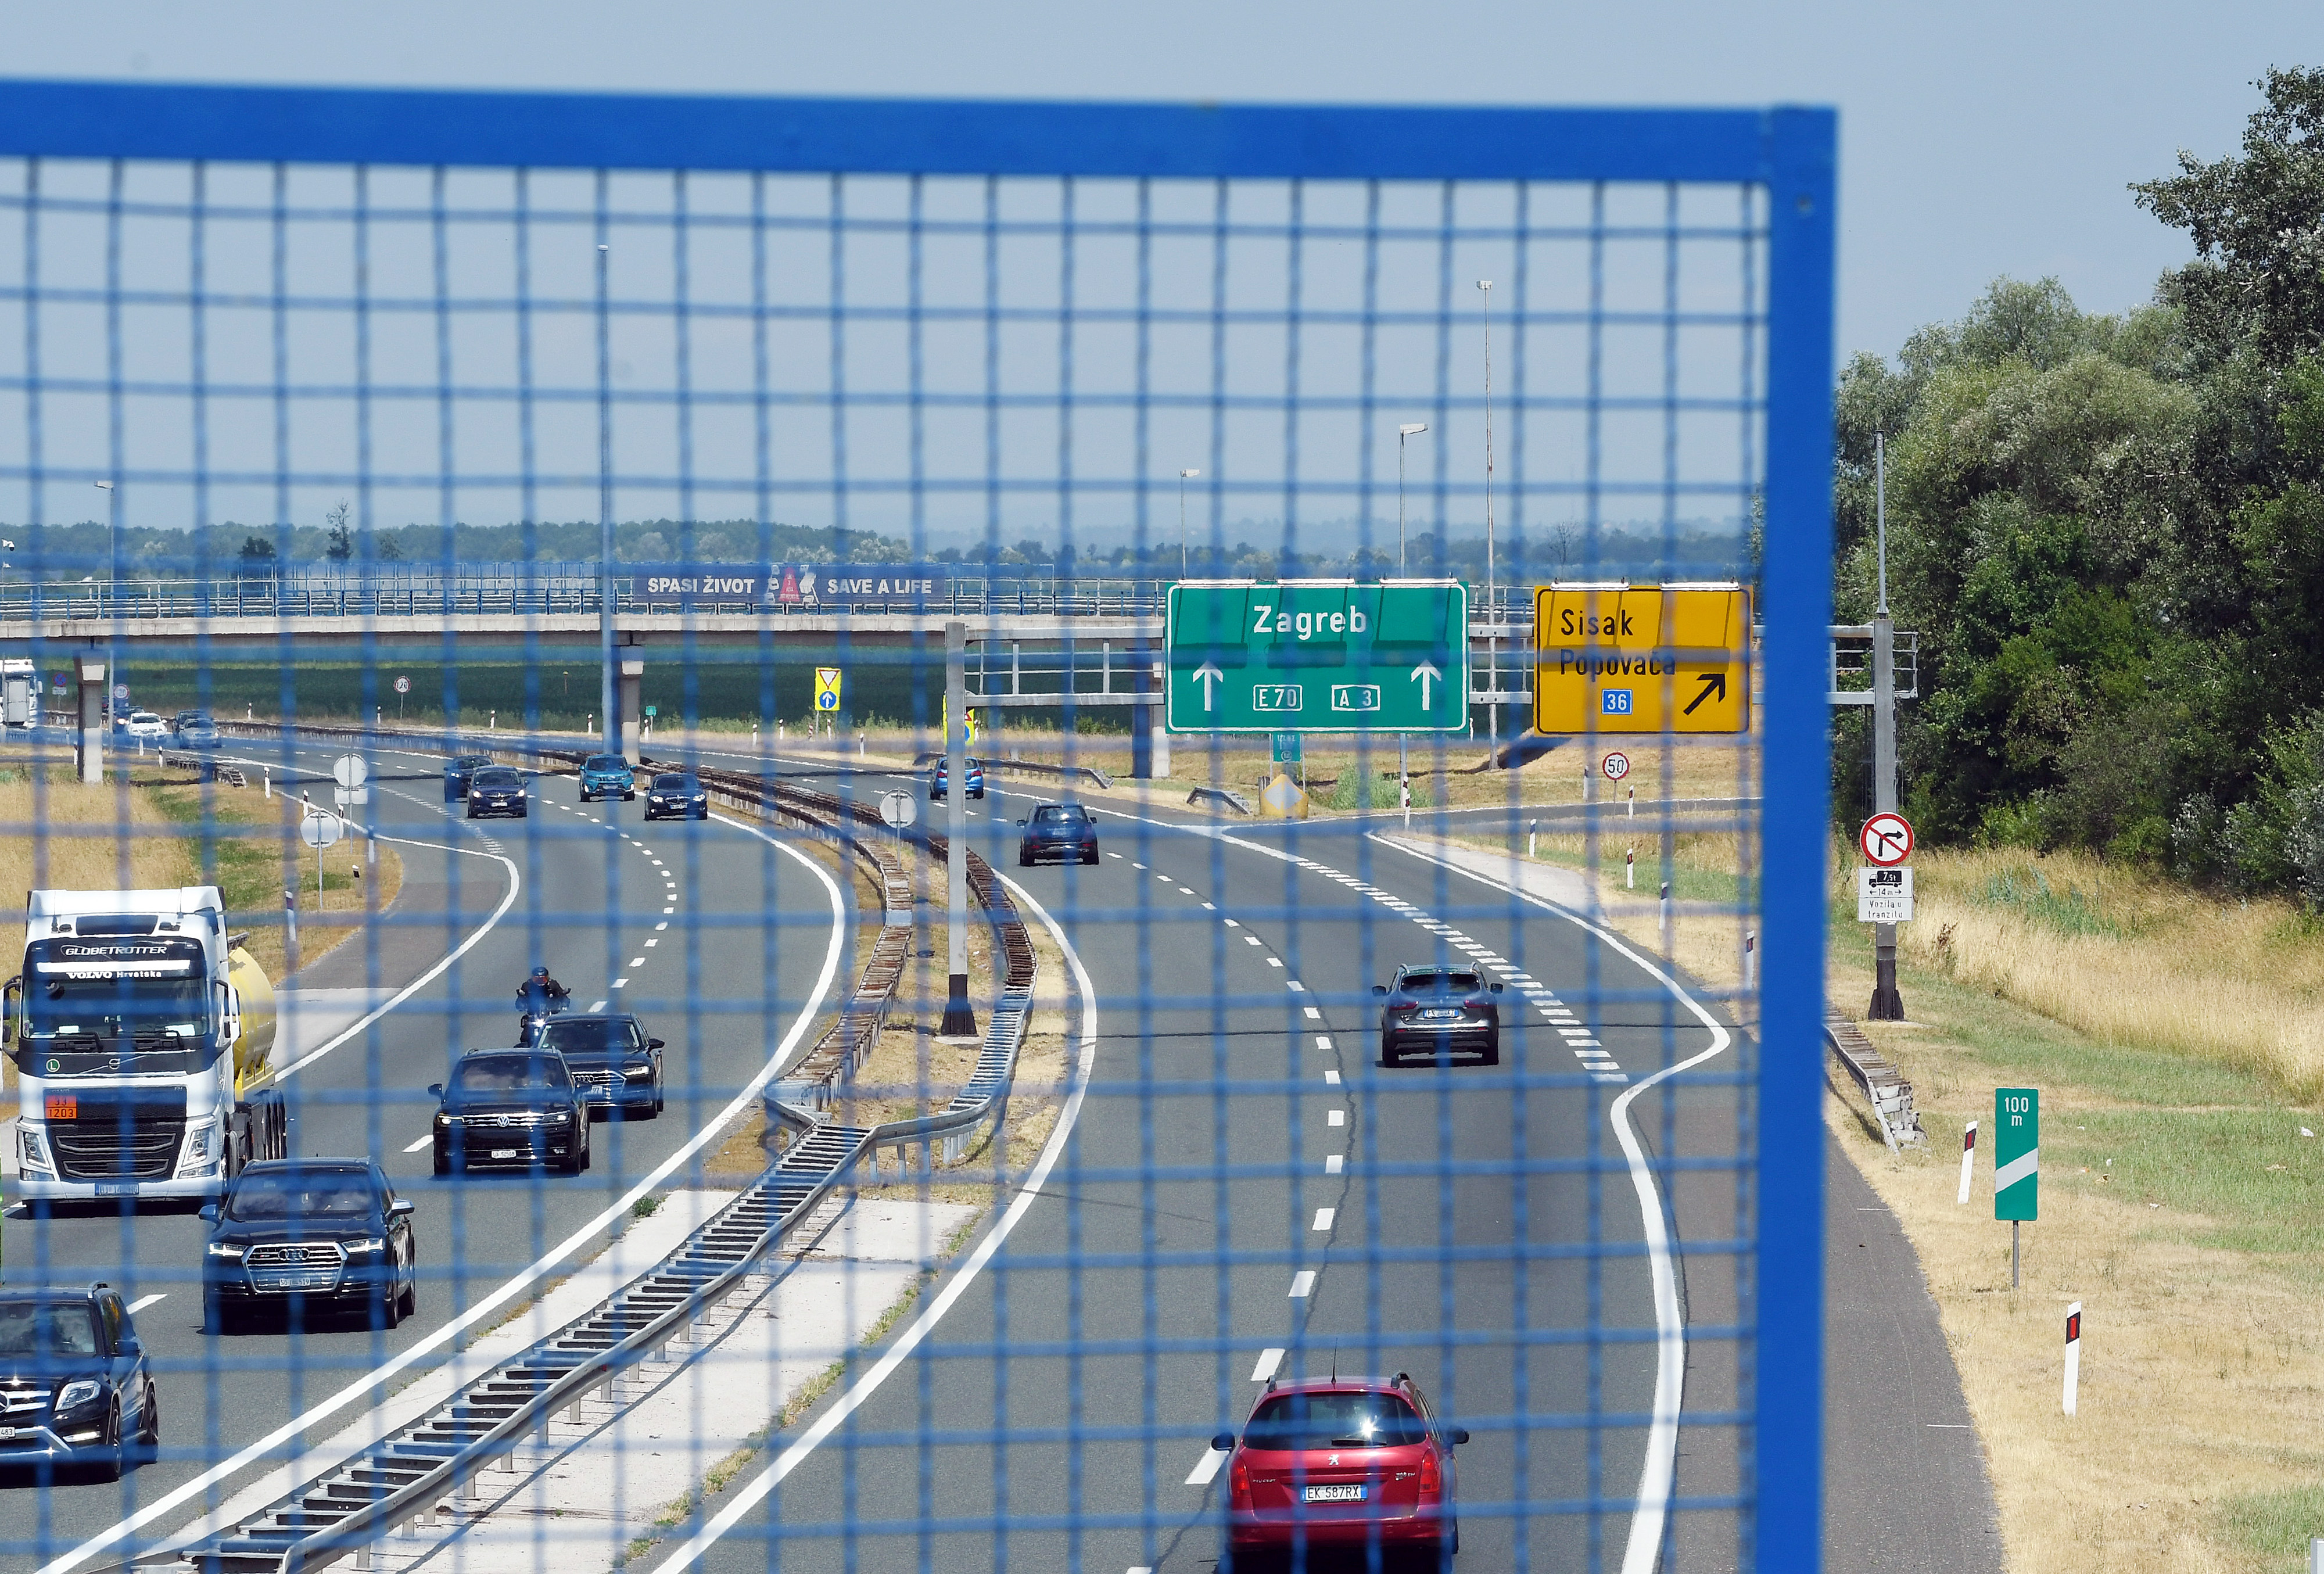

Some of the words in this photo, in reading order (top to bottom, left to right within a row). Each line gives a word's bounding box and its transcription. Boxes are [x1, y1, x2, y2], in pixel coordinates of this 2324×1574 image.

[648, 578, 697, 594] SPASI
[702, 575, 755, 594] ŽIVOT
[827, 579, 871, 594] SAVE
[877, 579, 890, 594] A
[895, 579, 932, 594] LIFE
[1253, 605, 1367, 640] Zagreb
[1561, 609, 1633, 636] Sisak
[1259, 689, 1268, 707] E
[1274, 689, 1297, 707] 70
[1339, 690, 1350, 707] A
[1362, 690, 1372, 707] 3
[1607, 694, 1627, 711] 36
[1608, 759, 1624, 773] 50
[1878, 888, 1886, 896] 14
[66, 946, 167, 956] GLOBETROTTER
[66, 971, 113, 980] VOLVO
[2005, 1097, 2029, 1113] 100
[49, 1108, 74, 1118] 1203
[2011, 1115, 2022, 1126] m
[1308, 1487, 1321, 1498] EK
